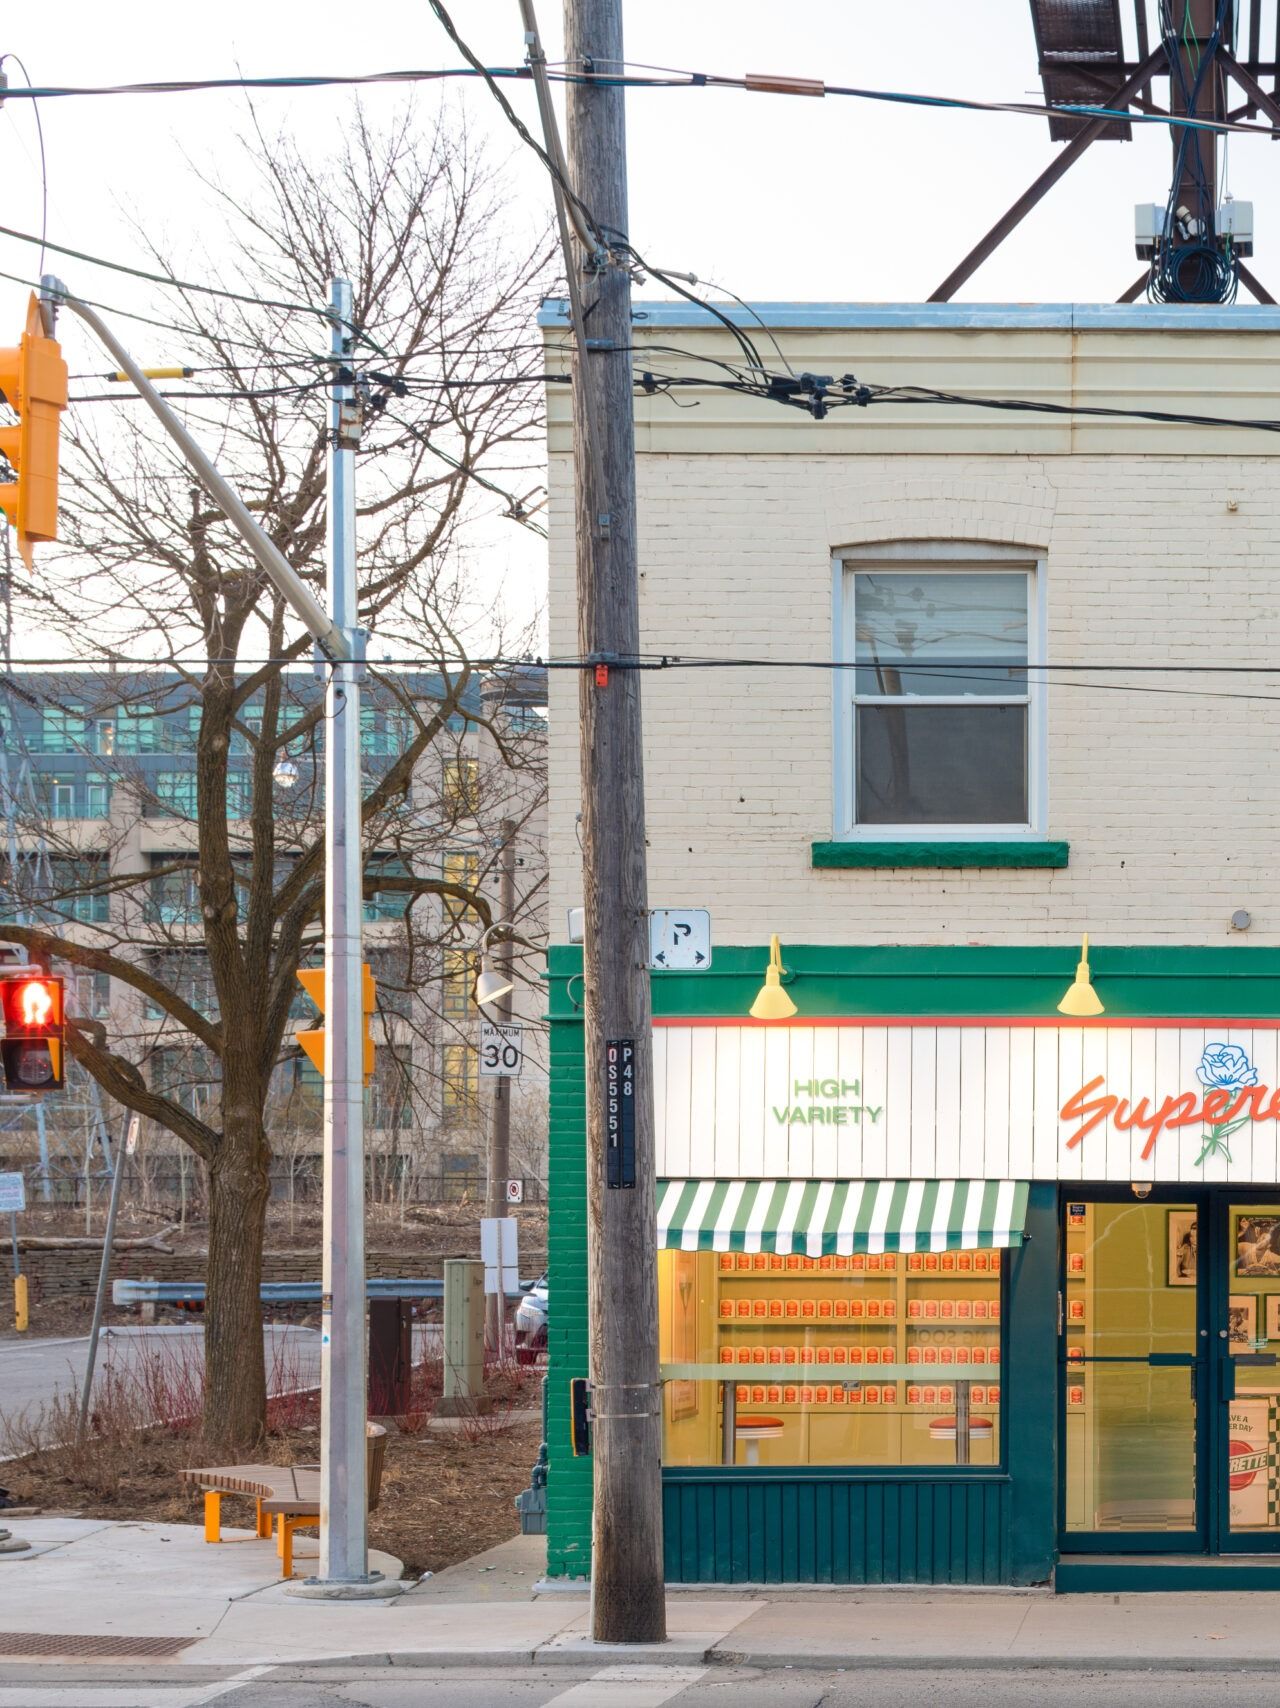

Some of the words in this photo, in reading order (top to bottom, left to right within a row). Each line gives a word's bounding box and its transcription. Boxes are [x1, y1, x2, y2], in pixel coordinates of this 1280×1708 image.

[673, 923, 692, 946] P
[484, 1044, 519, 1068] 30
[623, 1047, 633, 1096] P48
[793, 1078, 861, 1098] HIGH
[772, 1105, 883, 1125] VARIETY
[1239, 1424, 1253, 1432] DAY
[1229, 1453, 1267, 1472] RETTE
